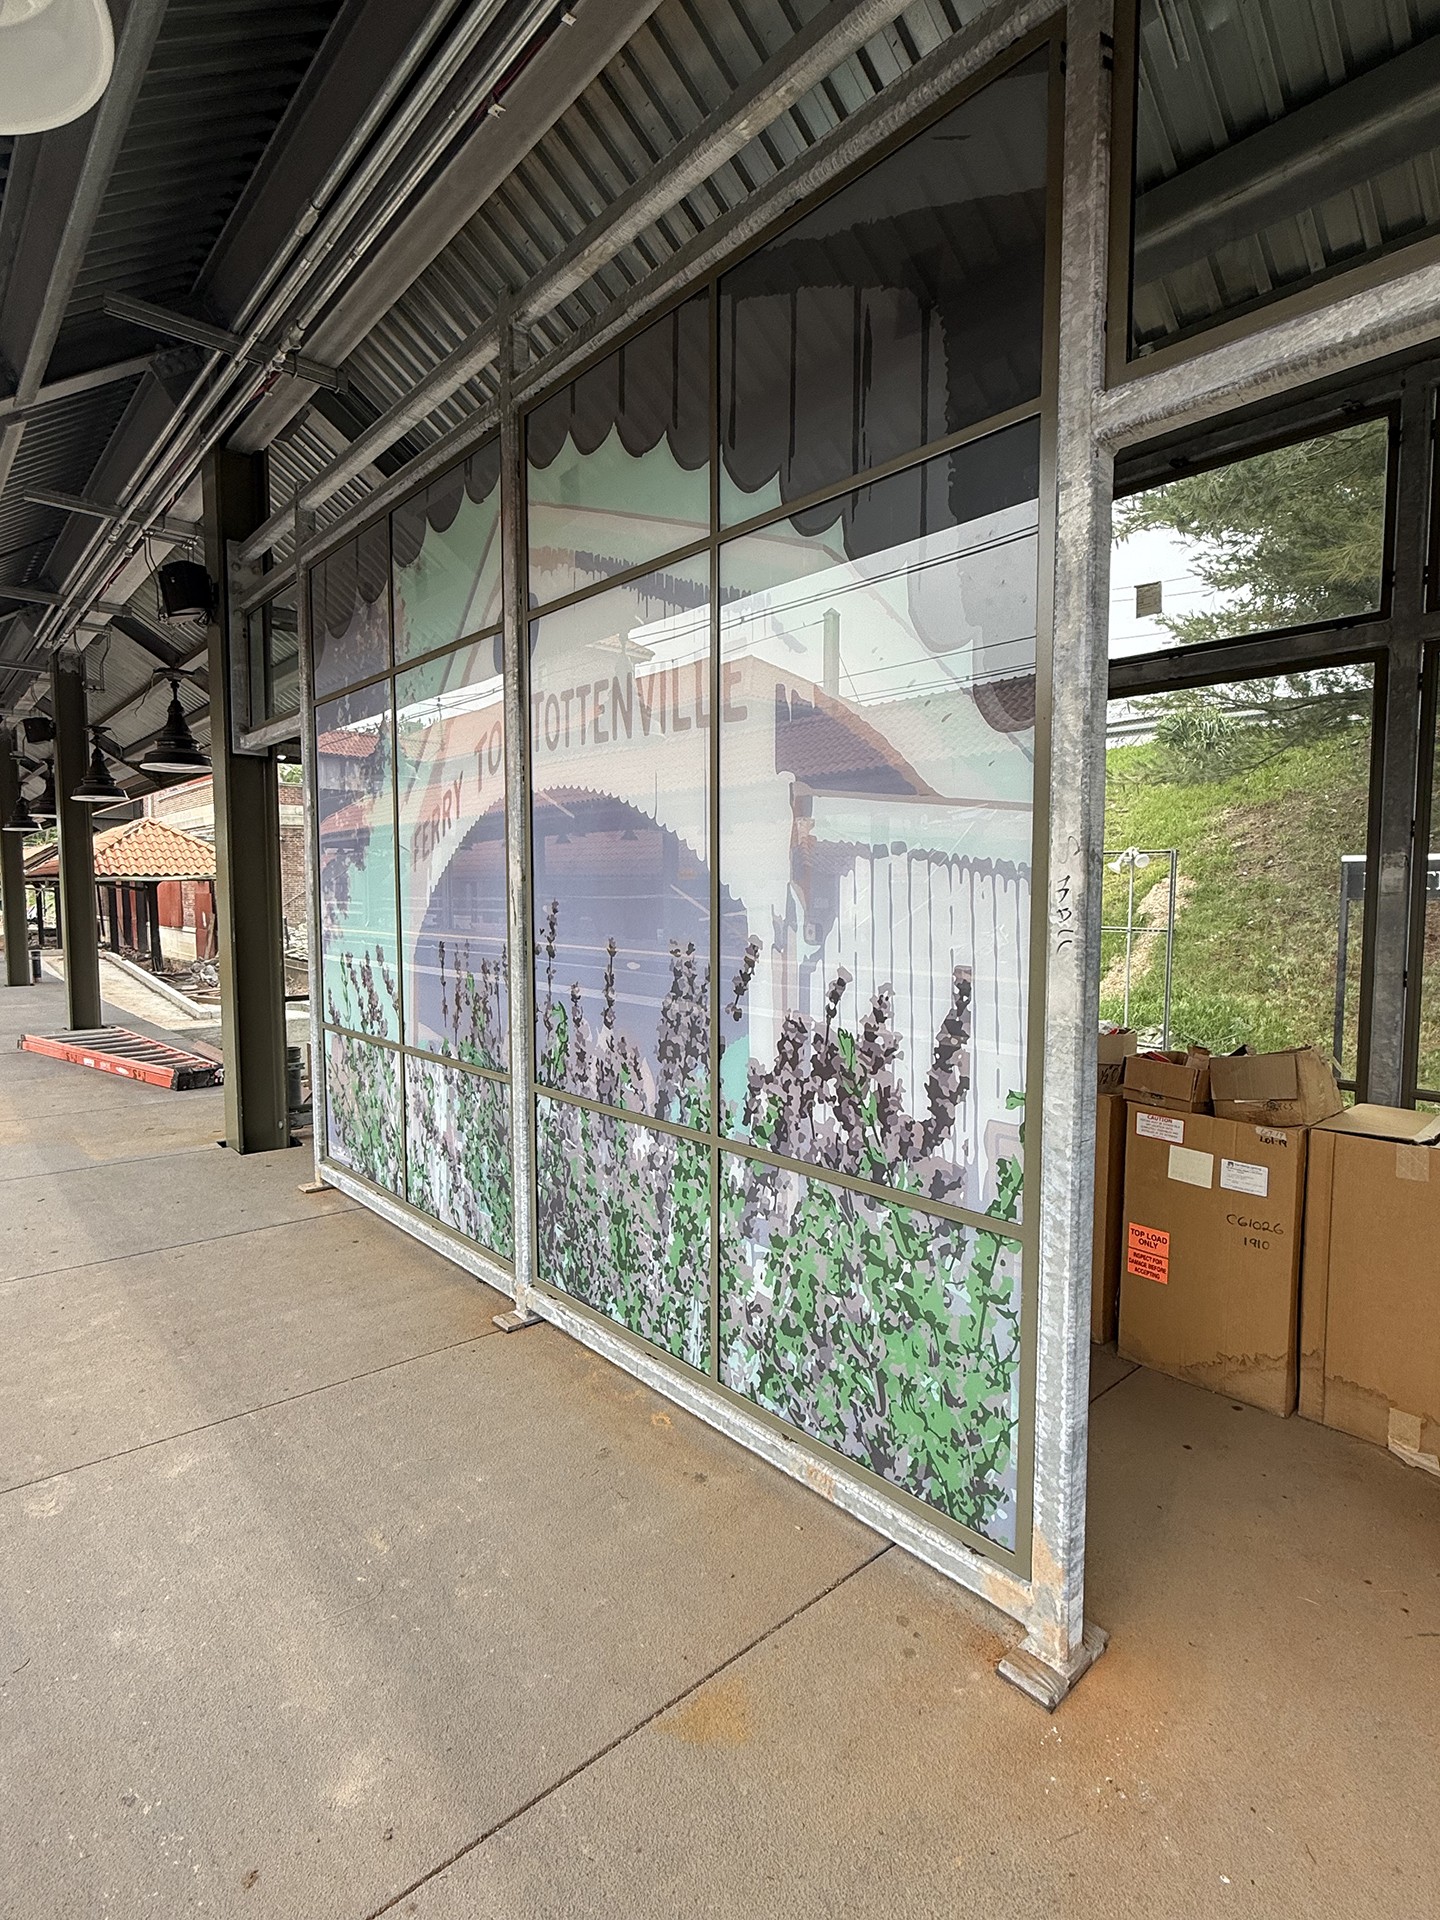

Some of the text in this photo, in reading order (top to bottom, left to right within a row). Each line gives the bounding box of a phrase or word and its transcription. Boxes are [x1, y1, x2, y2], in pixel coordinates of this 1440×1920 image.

[412, 656, 748, 872] FERRY TO TOTTENVILLE
[1131, 1228, 1168, 1245] TOP LOAD
[1138, 1238, 1158, 1249] ONLY
[1244, 1237, 1270, 1250] 1910
[1153, 1258, 1163, 1266] FOR
